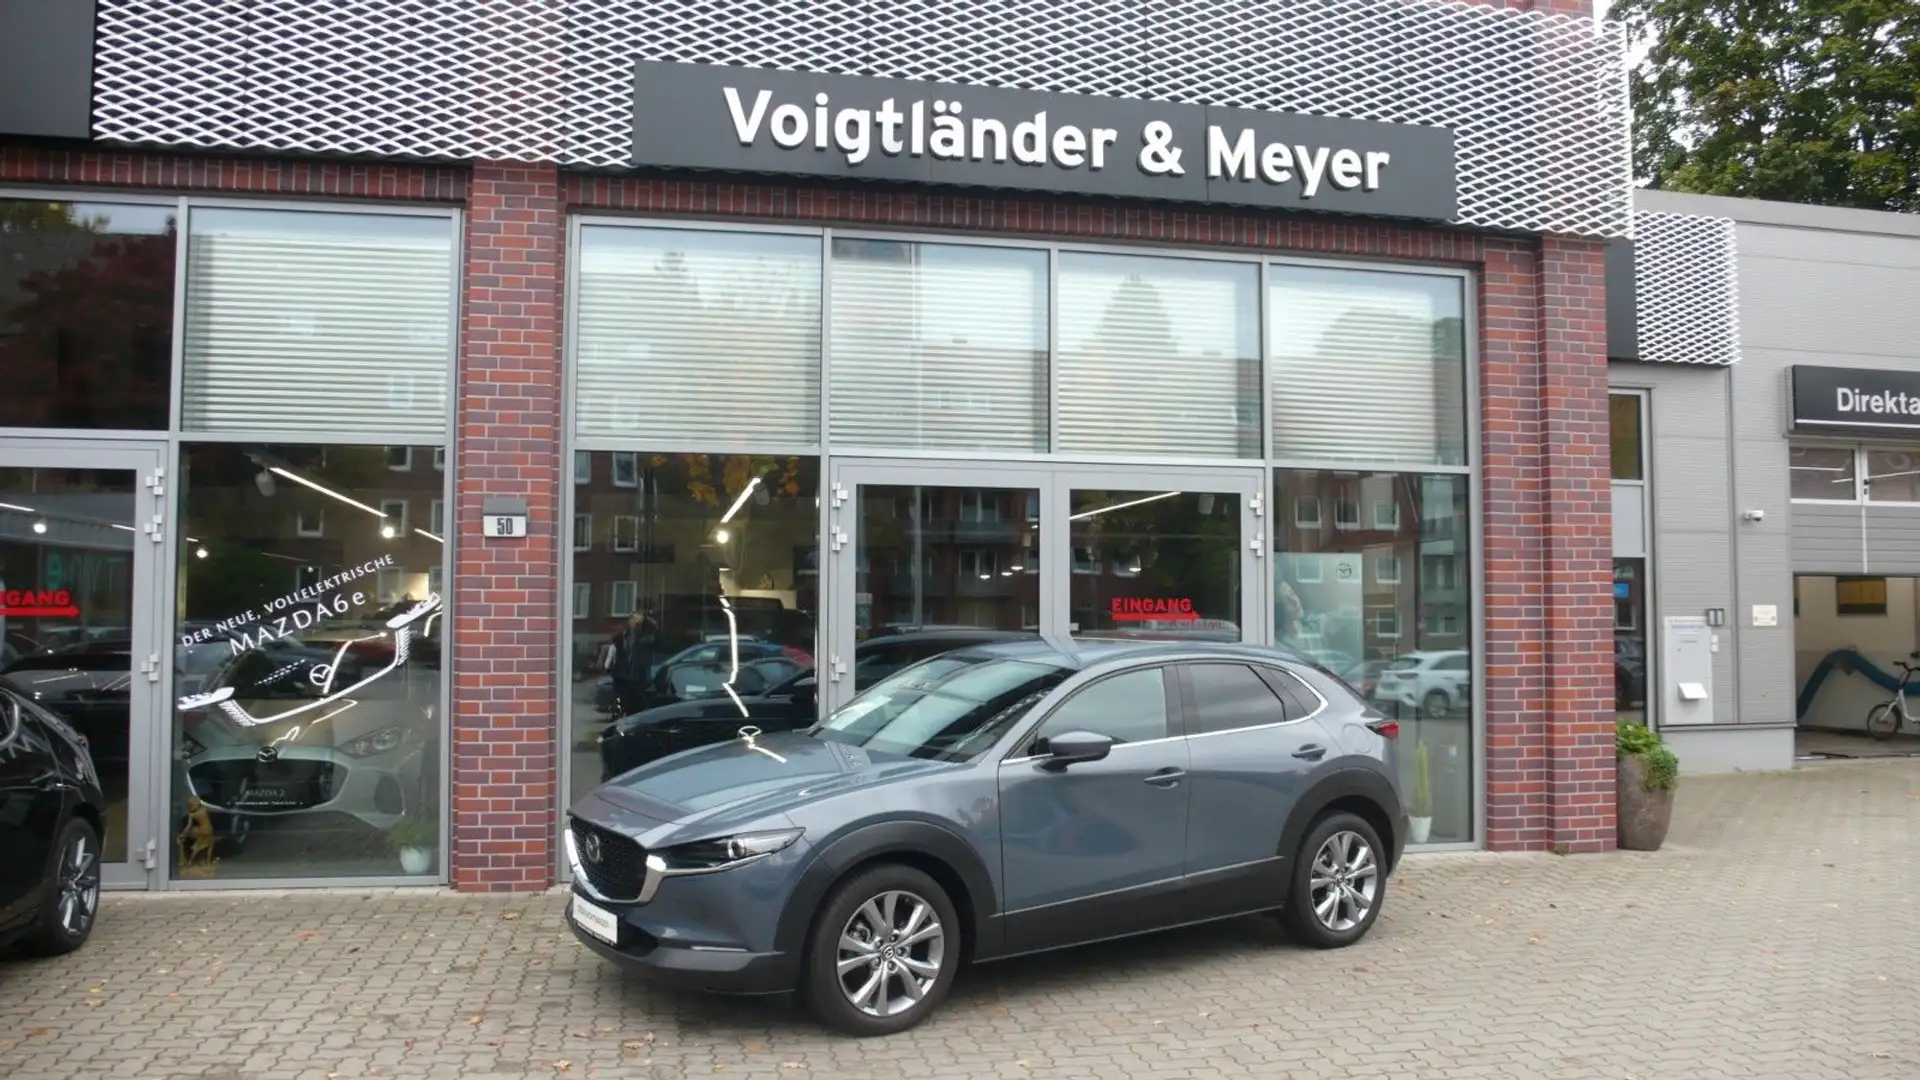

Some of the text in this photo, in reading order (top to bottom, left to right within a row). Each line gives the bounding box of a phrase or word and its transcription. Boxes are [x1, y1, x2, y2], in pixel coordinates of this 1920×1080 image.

[723, 87, 1391, 198] Voigtländer & Meyer
[496, 517, 514, 535] 50
[181, 554, 395, 648] DER NEUE, VOLLELEKTRISCHE
[228, 591, 367, 656] MAZDA6e
[1111, 597, 1193, 613] EINGANG
